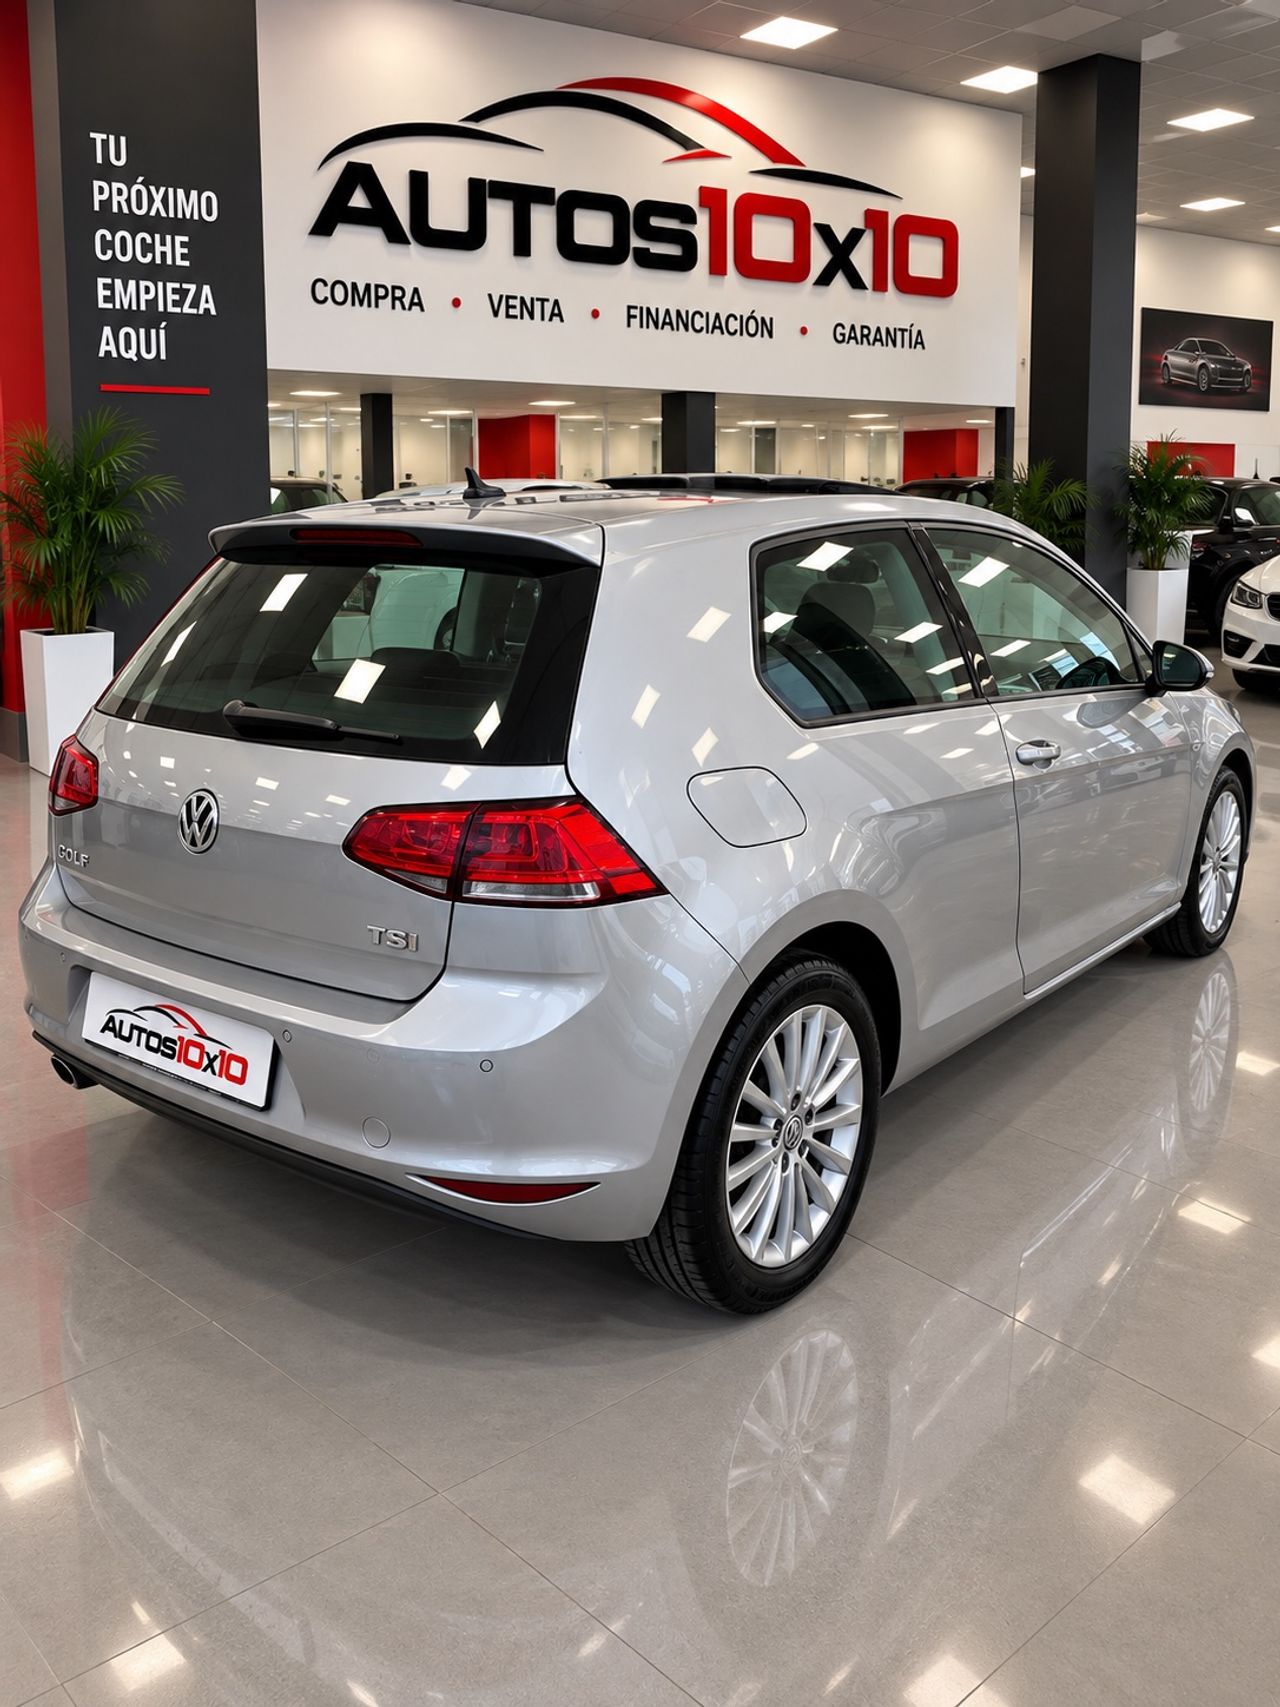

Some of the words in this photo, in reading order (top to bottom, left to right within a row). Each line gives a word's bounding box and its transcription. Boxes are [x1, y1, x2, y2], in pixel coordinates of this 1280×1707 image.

[90, 132, 127, 167] TU
[93, 177, 218, 222] PRÓXIMO
[95, 229, 190, 267] COCHE
[308, 161, 959, 300] AUTOS10x10
[97, 278, 216, 316] EMPIEZA
[311, 278, 425, 312] COMPRA
[488, 294, 564, 322] VENTA
[627, 304, 774, 339] FINANCIACIÓN
[833, 323, 926, 350] GARANTÍA
[98, 322, 167, 362] AQUÍ
[58, 844, 90, 867] GOLF
[367, 924, 418, 952] TSI
[100, 1014, 249, 1087] AUTOS10x10
